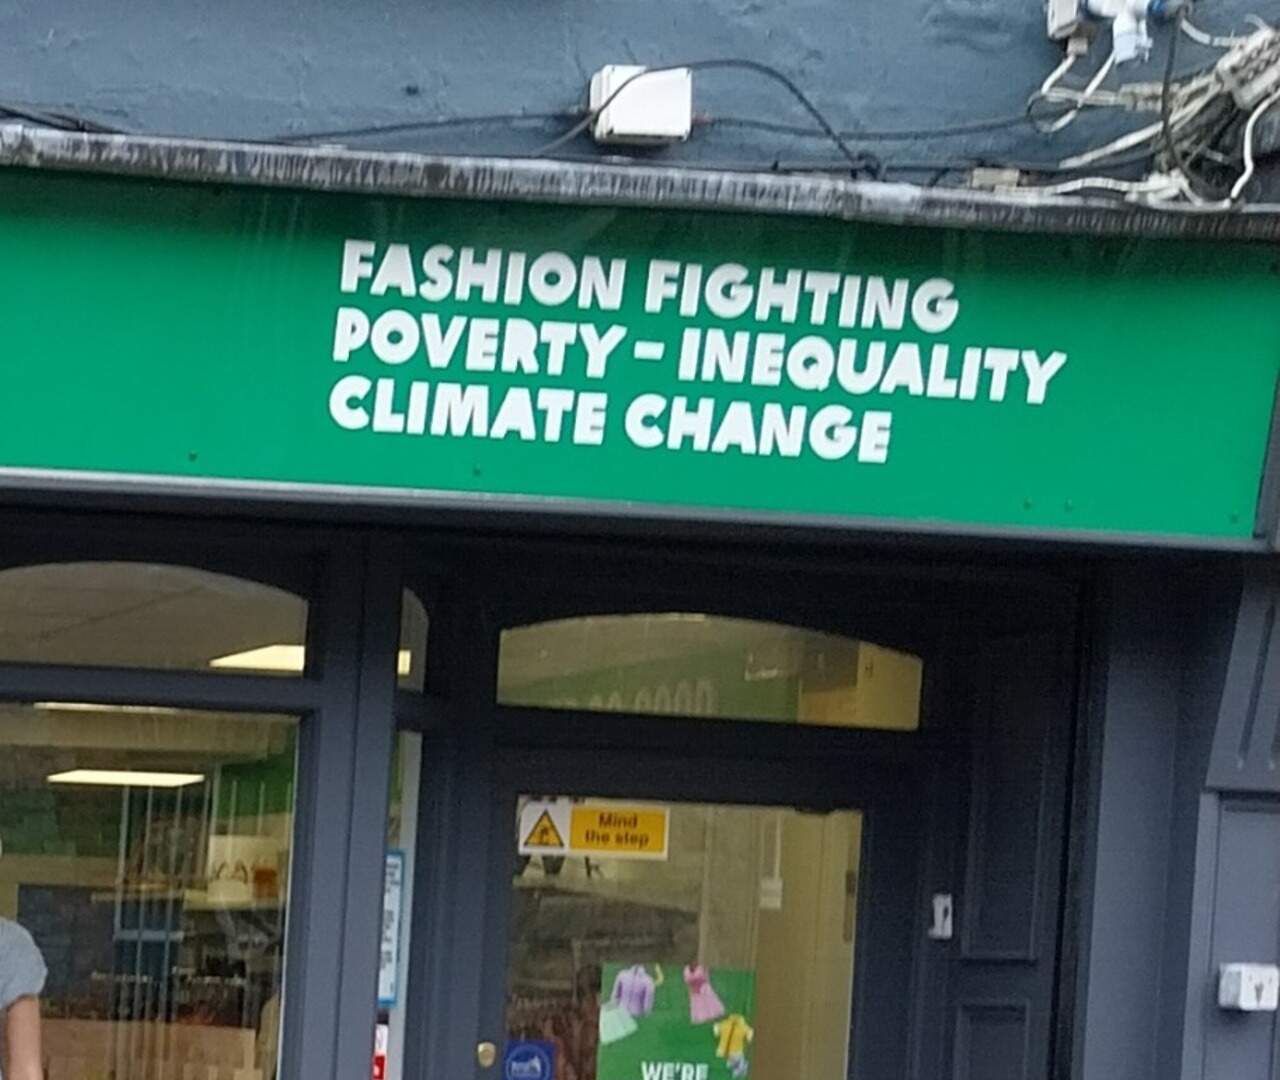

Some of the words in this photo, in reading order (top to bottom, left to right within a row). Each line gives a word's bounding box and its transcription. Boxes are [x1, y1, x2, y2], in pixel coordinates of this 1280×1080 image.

[340, 238, 627, 311] FASHION
[644, 258, 960, 333] FIGHTING
[332, 306, 628, 379] POVERTY
[677, 327, 1068, 405] INEQUALITY
[328, 374, 608, 446] CLIMATE
[624, 392, 893, 464] CHANGE
[585, 829, 610, 843] the
[615, 831, 649, 849] step
[598, 812, 638, 829] Mind
